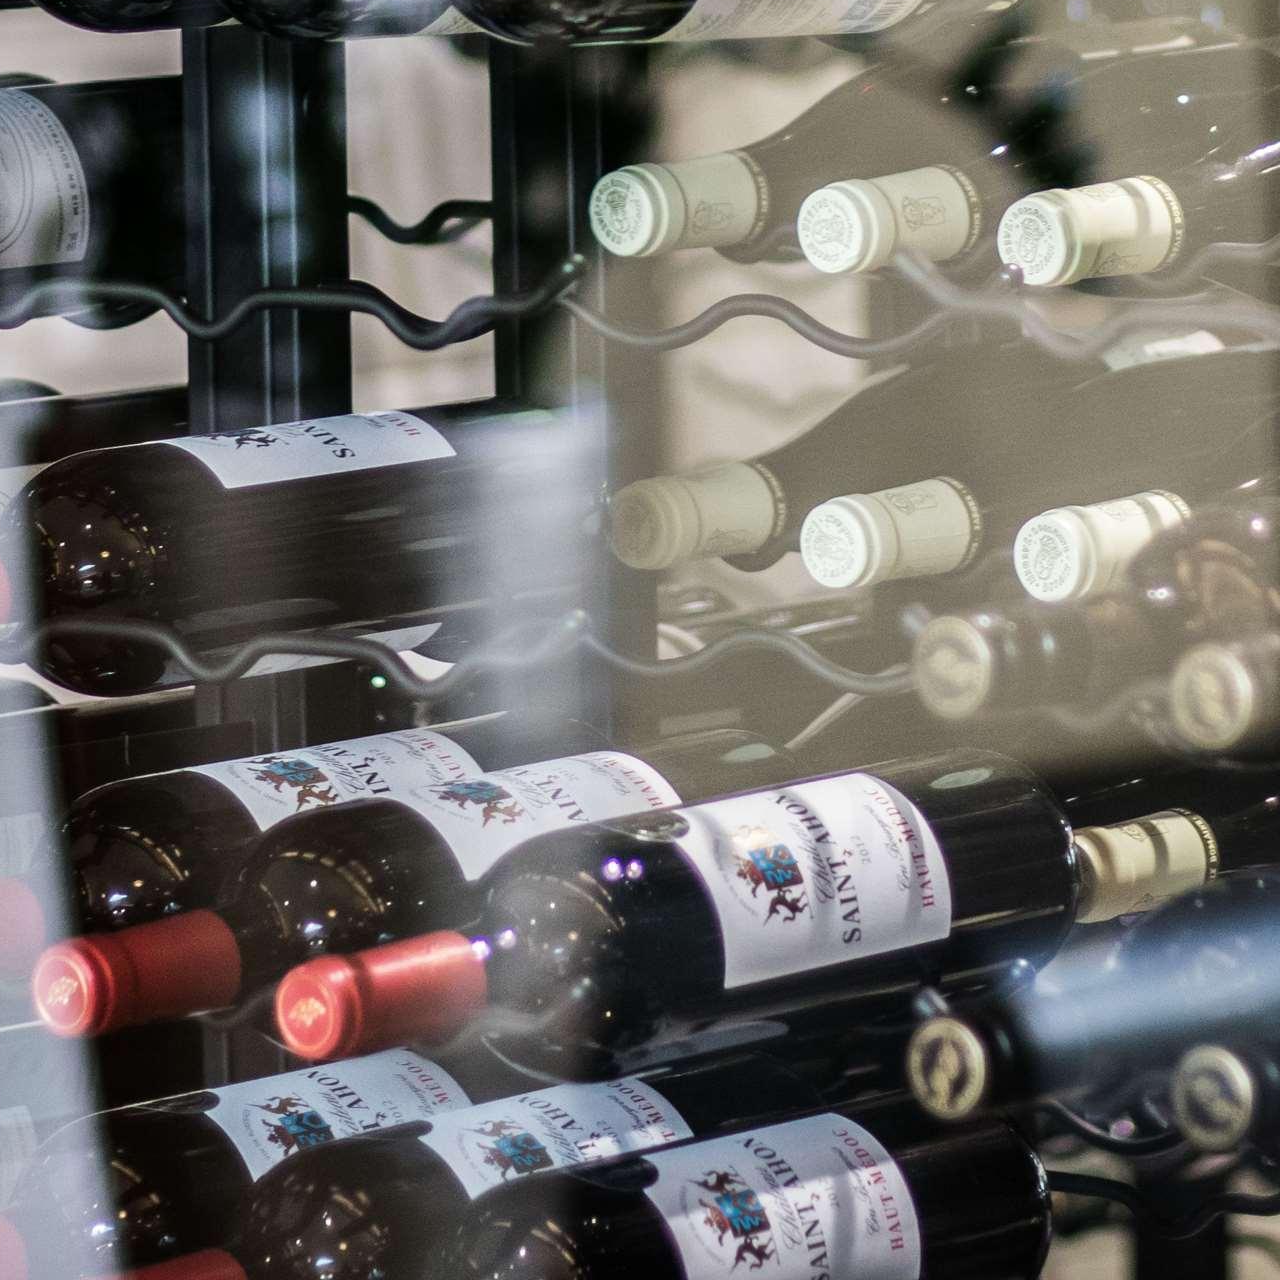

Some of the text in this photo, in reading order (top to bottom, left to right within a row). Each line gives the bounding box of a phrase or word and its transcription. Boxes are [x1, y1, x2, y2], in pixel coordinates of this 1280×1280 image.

[348, 760, 392, 795] INT
[533, 778, 591, 822] AINT
[775, 794, 863, 945] SAINT AHON
[741, 1136, 806, 1190] AHON
[832, 1126, 905, 1251] HAUT-MÉDOC
